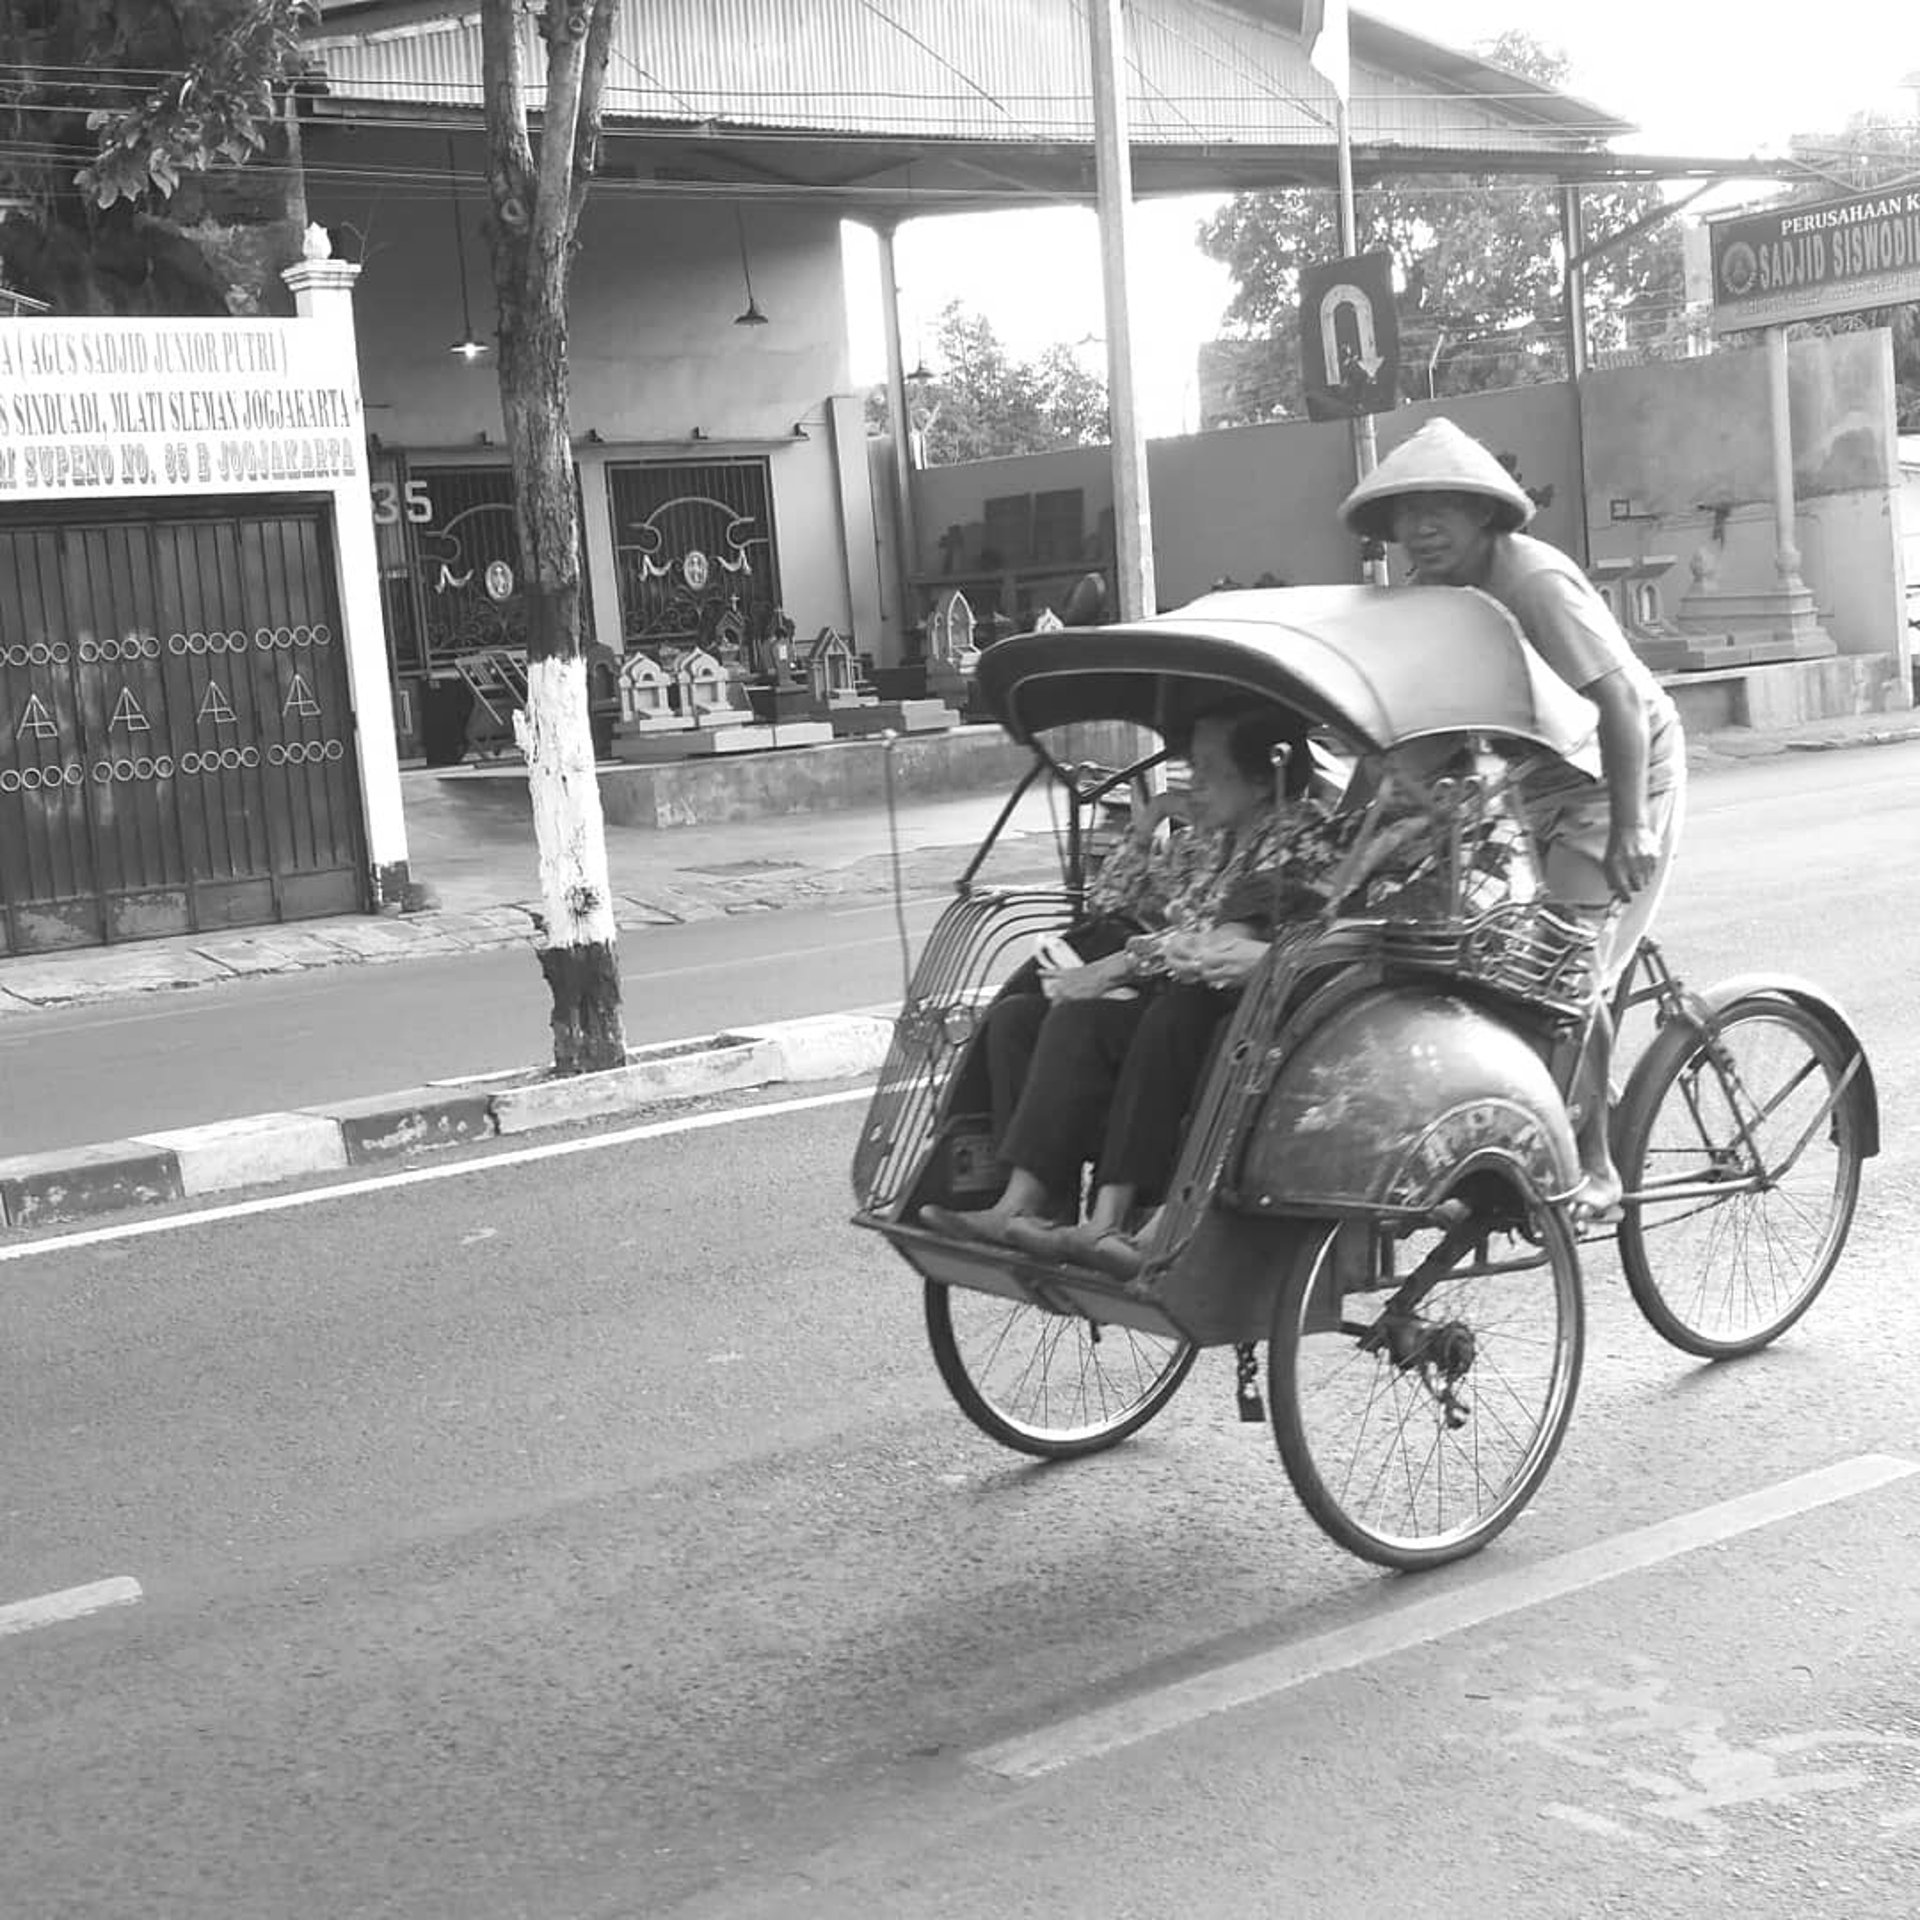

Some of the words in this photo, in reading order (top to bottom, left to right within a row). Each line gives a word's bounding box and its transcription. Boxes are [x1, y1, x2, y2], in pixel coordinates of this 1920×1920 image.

[1781, 197, 1901, 236] PERUSAHAAN
[1760, 234, 1825, 290] SADJID
[82, 331, 149, 374] SADJID
[154, 331, 220, 373] JUNIOR
[110, 391, 166, 432] MLATI
[169, 390, 239, 431] SLEMAN
[243, 388, 351, 430] JOGJAKARTA
[24, 444, 115, 487] SUPENO
[218, 437, 356, 482] JOGJAKARTA
[371, 481, 433, 524] 35
